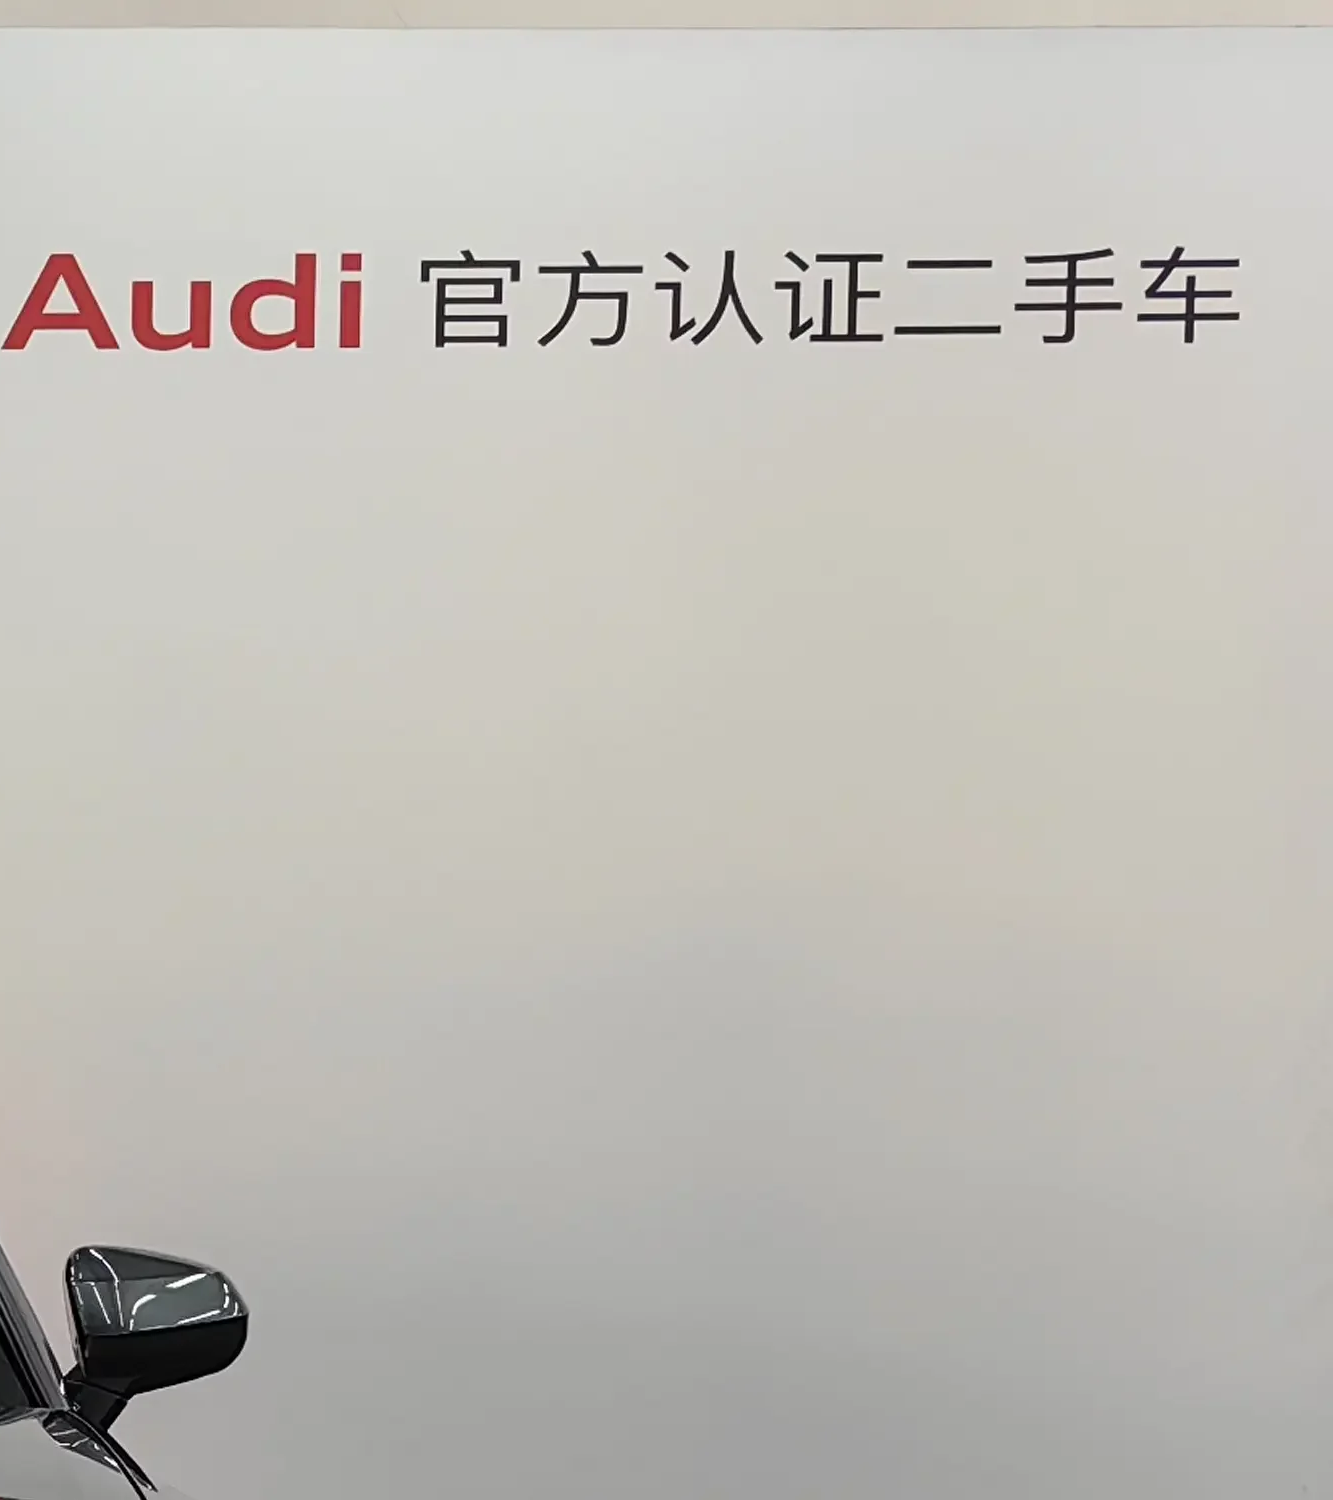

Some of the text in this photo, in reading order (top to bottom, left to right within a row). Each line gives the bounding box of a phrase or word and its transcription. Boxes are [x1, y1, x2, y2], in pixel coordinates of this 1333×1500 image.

[0, 246, 1241, 352] Audi 官方认证二手车
